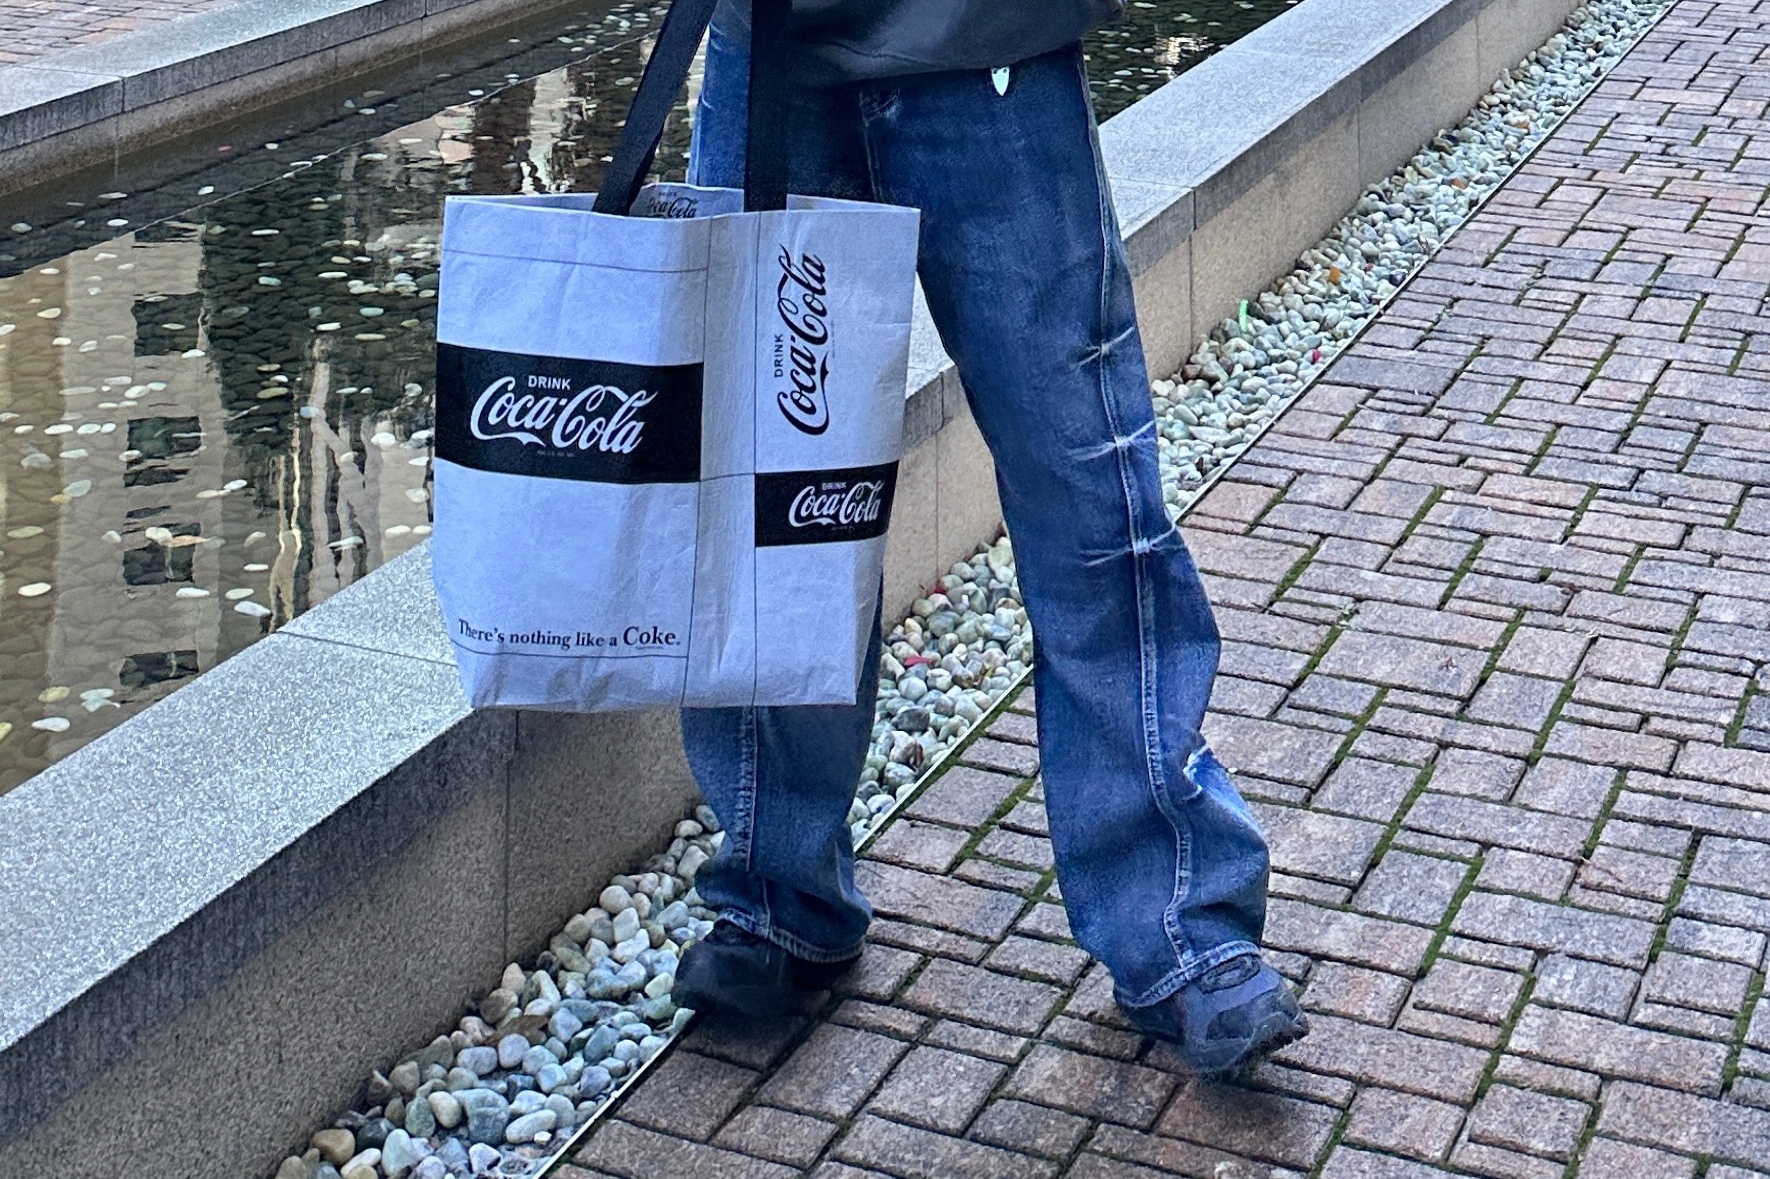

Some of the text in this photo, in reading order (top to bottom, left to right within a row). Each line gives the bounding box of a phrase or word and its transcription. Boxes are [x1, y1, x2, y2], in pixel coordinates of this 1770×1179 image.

[774, 333, 783, 378] DRINK
[777, 243, 830, 436] Coca-Cola
[528, 375, 571, 391] DRINK
[470, 376, 659, 455] Coca-Cola
[788, 480, 885, 528] Coca-Cola
[459, 618, 681, 651] There's nothing like a Coke.
